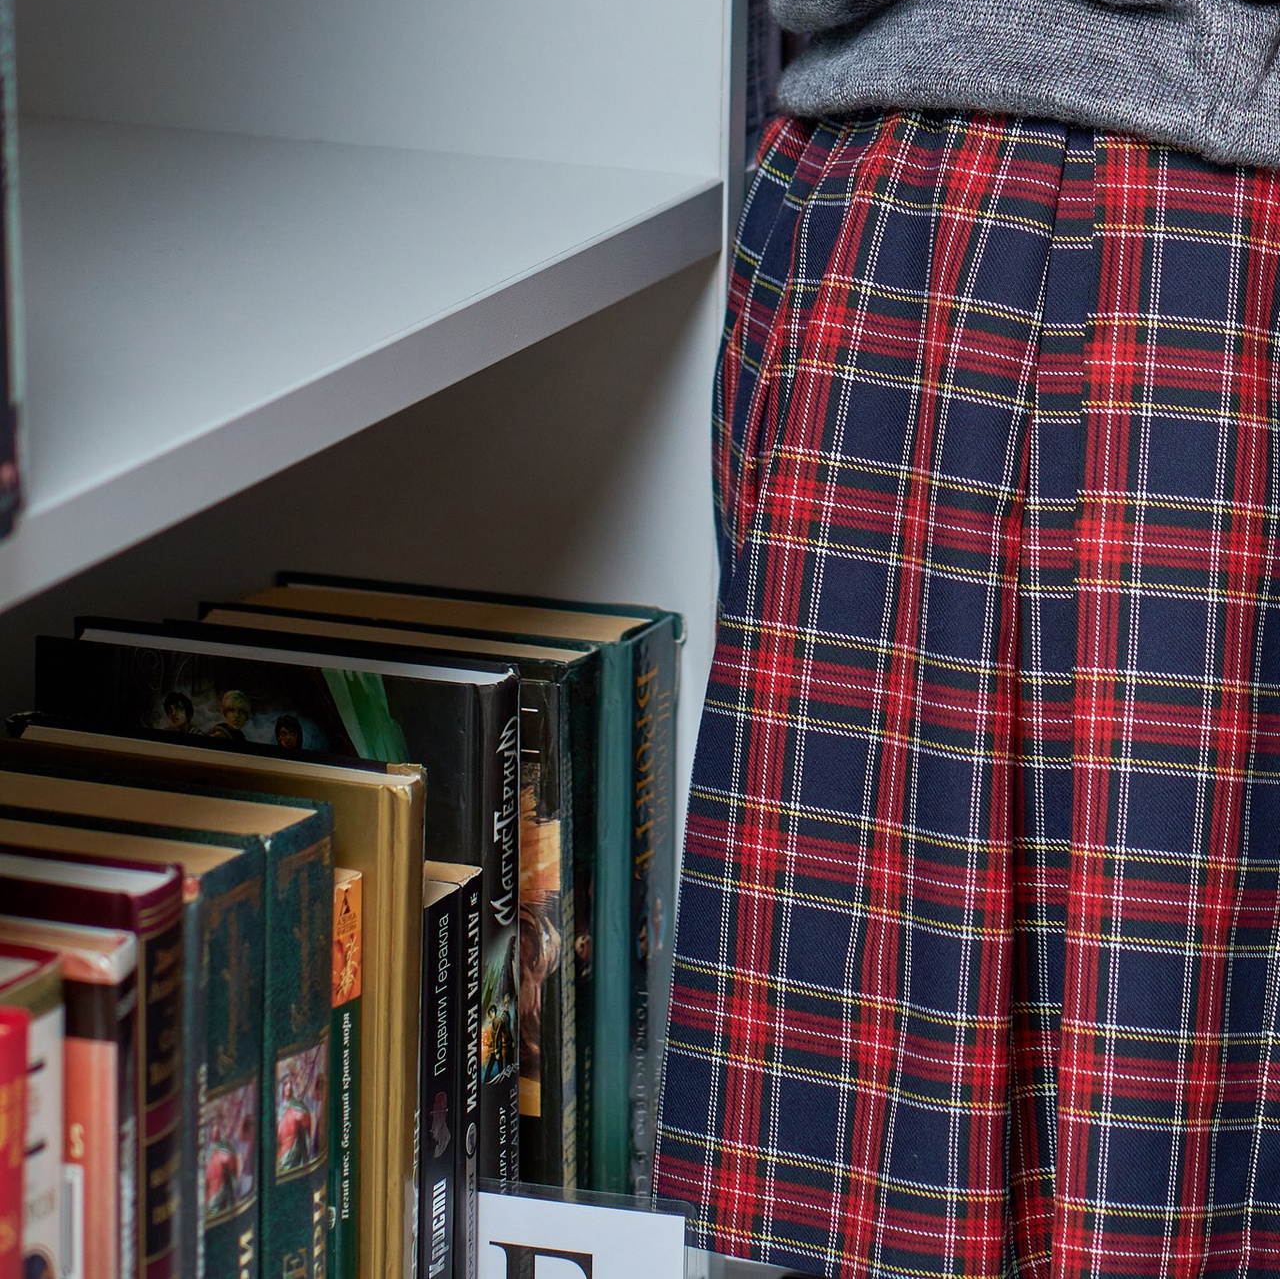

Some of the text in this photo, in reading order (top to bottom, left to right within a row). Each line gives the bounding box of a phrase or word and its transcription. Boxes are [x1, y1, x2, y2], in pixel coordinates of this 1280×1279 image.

[635, 665, 660, 881] БРОНТЕ
[434, 912, 450, 1077] Подвиги Геракла
[466, 913, 480, 1114] АГАТА КРИСТИ
[341, 1012, 351, 1219] Пегий пес, бегущий краем моря
[499, 1106, 507, 1145] КЛЭР
[429, 1177, 448, 1278] Кристи
